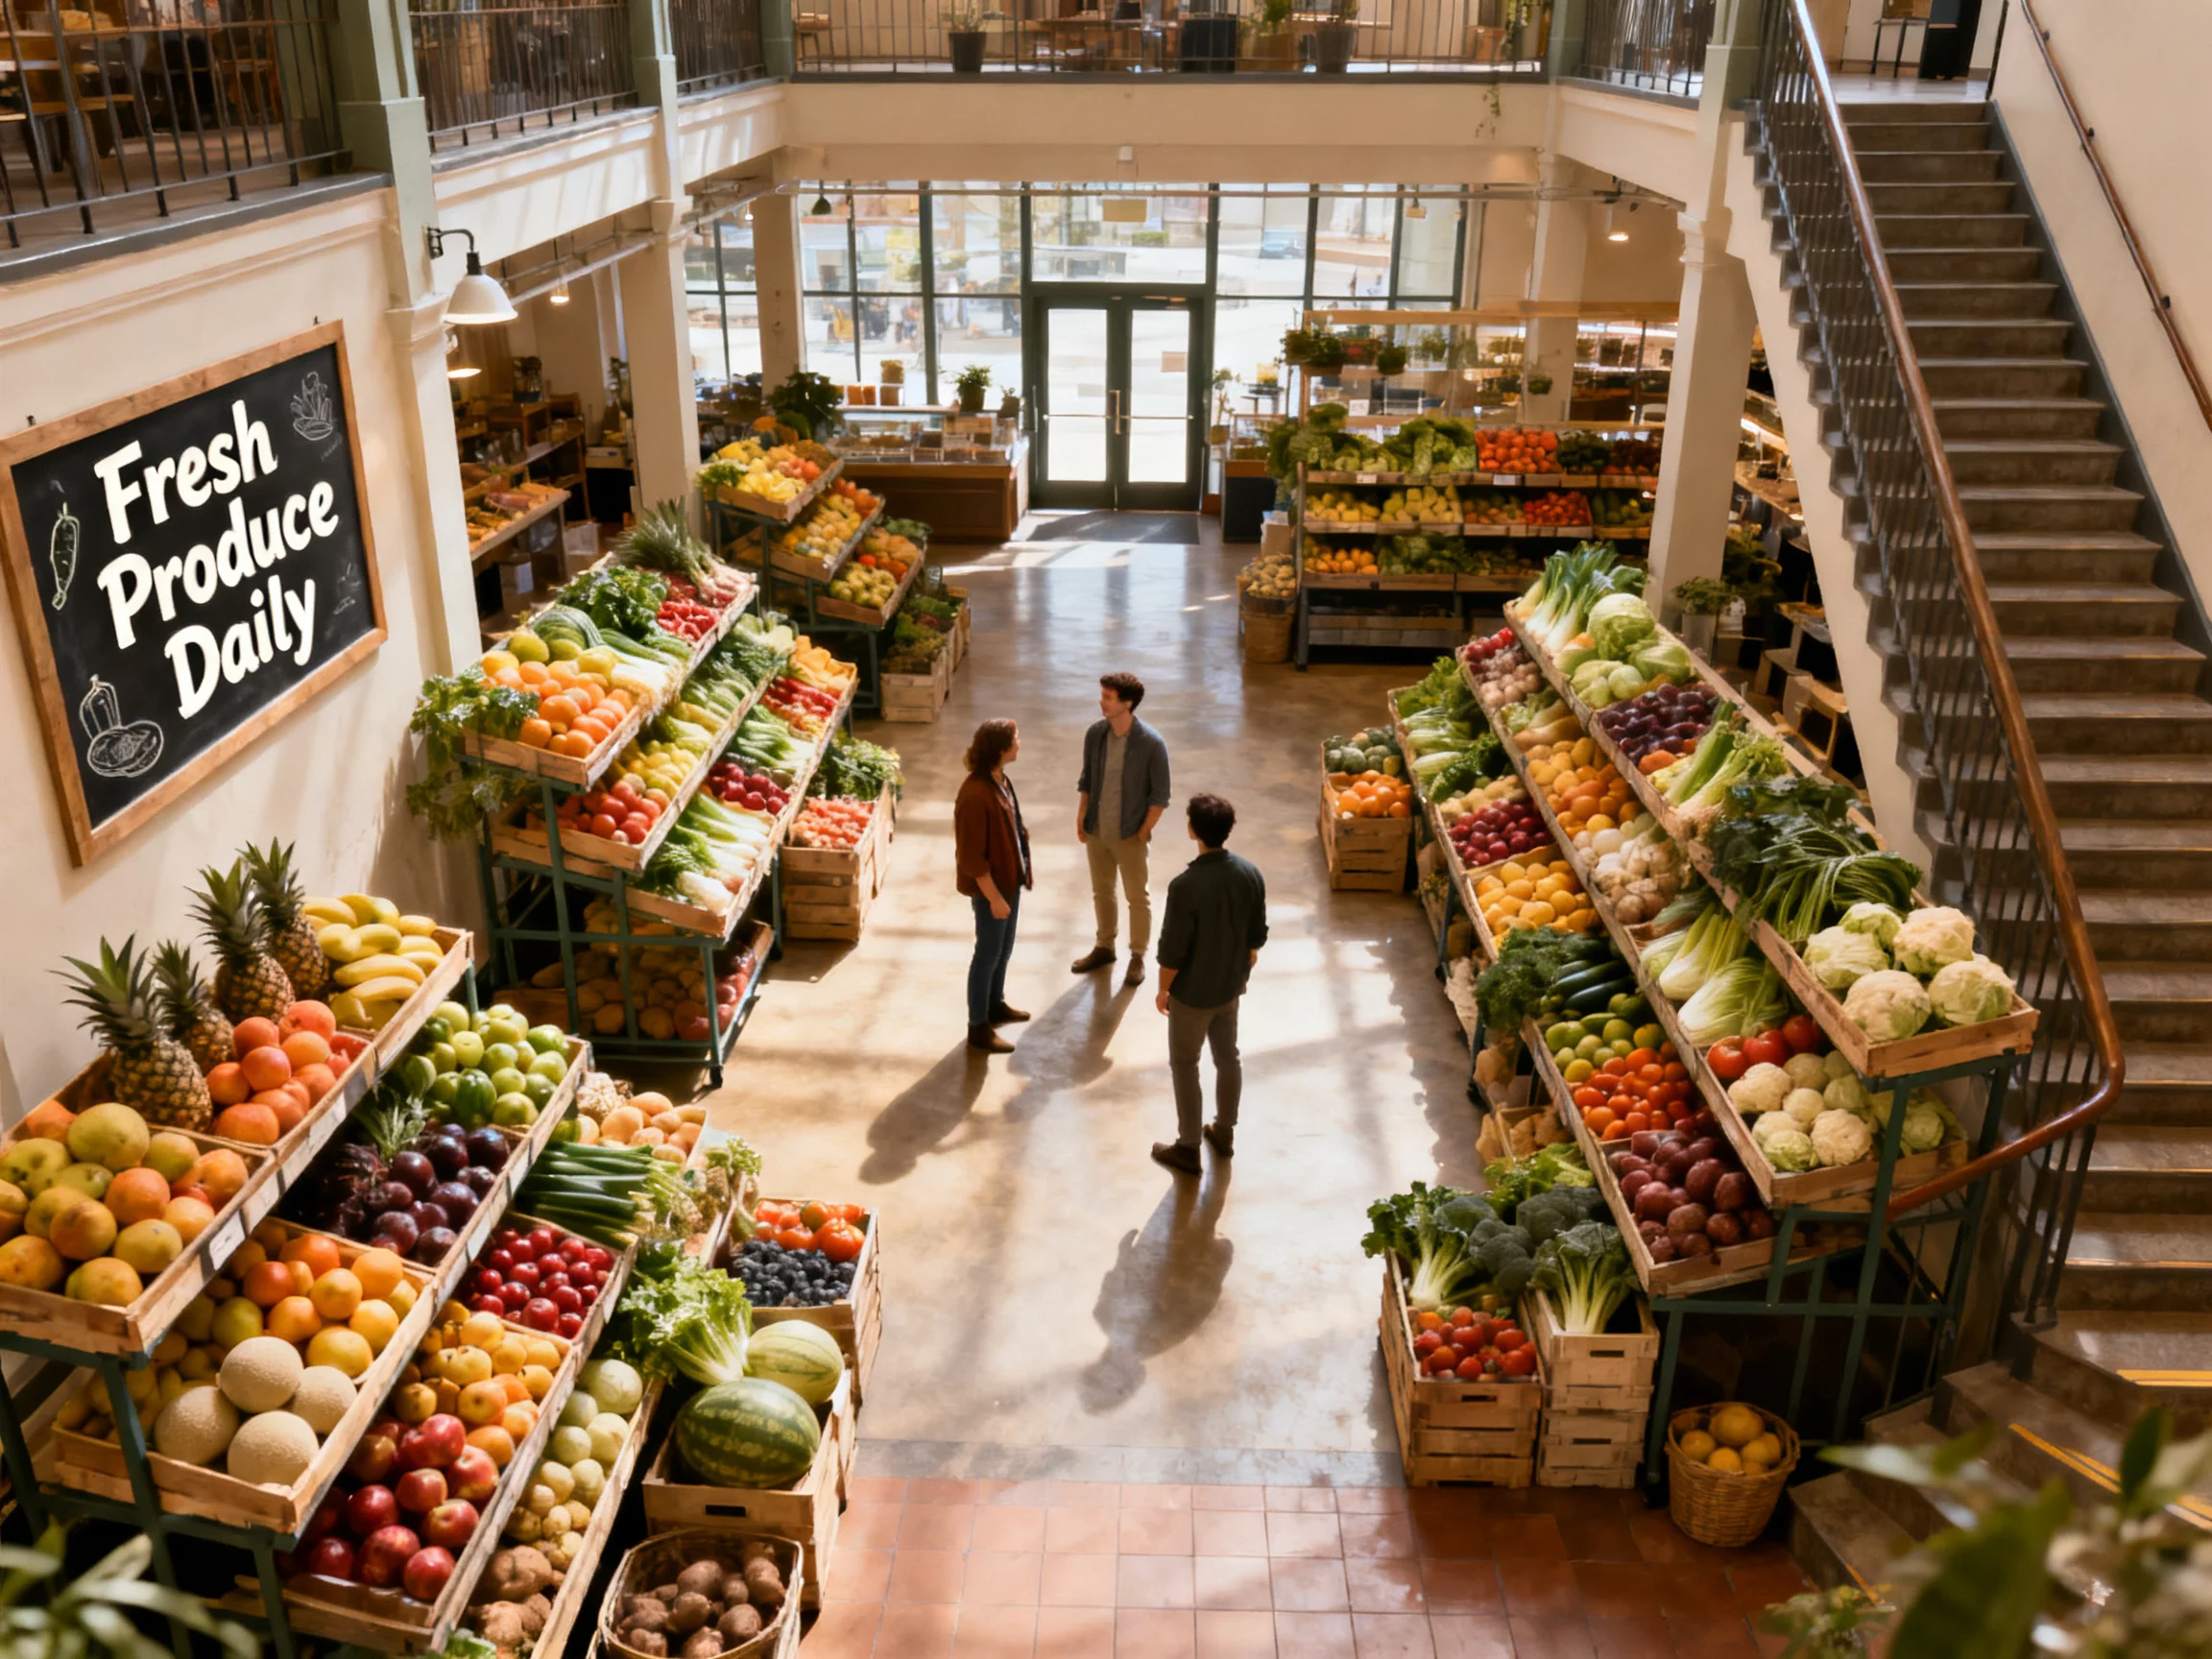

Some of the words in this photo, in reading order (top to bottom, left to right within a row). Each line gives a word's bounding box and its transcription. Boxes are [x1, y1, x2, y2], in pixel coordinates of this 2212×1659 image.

[93, 399, 278, 544] Fresh
[97, 481, 339, 650] Produce
[163, 573, 317, 720] Daily
